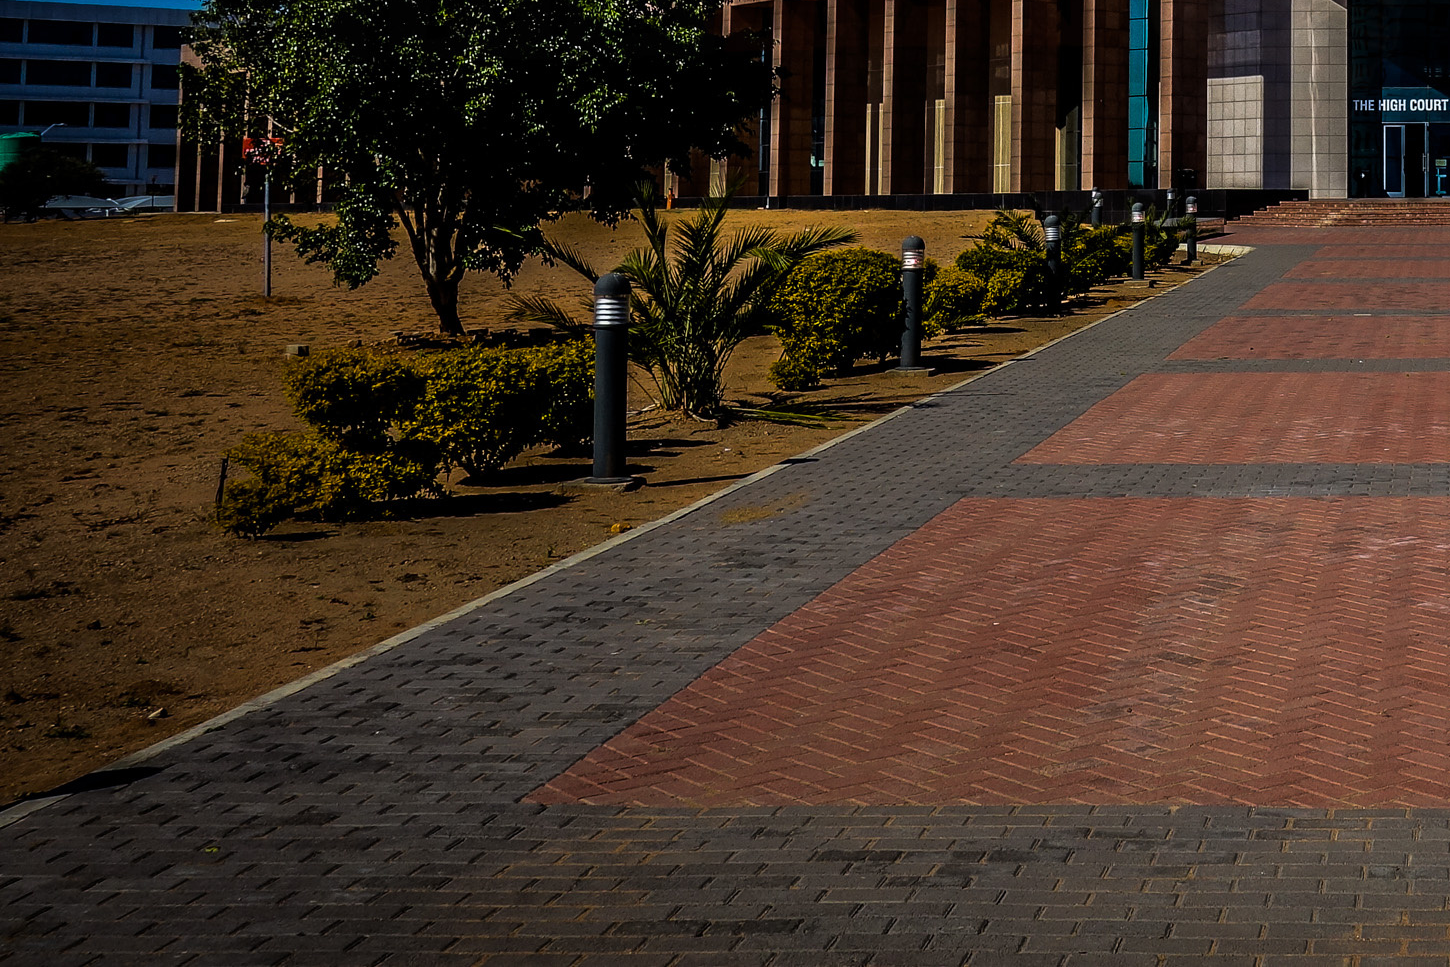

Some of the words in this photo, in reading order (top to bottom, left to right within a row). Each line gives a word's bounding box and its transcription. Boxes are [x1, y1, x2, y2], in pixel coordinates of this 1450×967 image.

[1353, 99, 1375, 111] THE
[1378, 99, 1407, 111] HIGH
[1409, 99, 1449, 111] COURT
